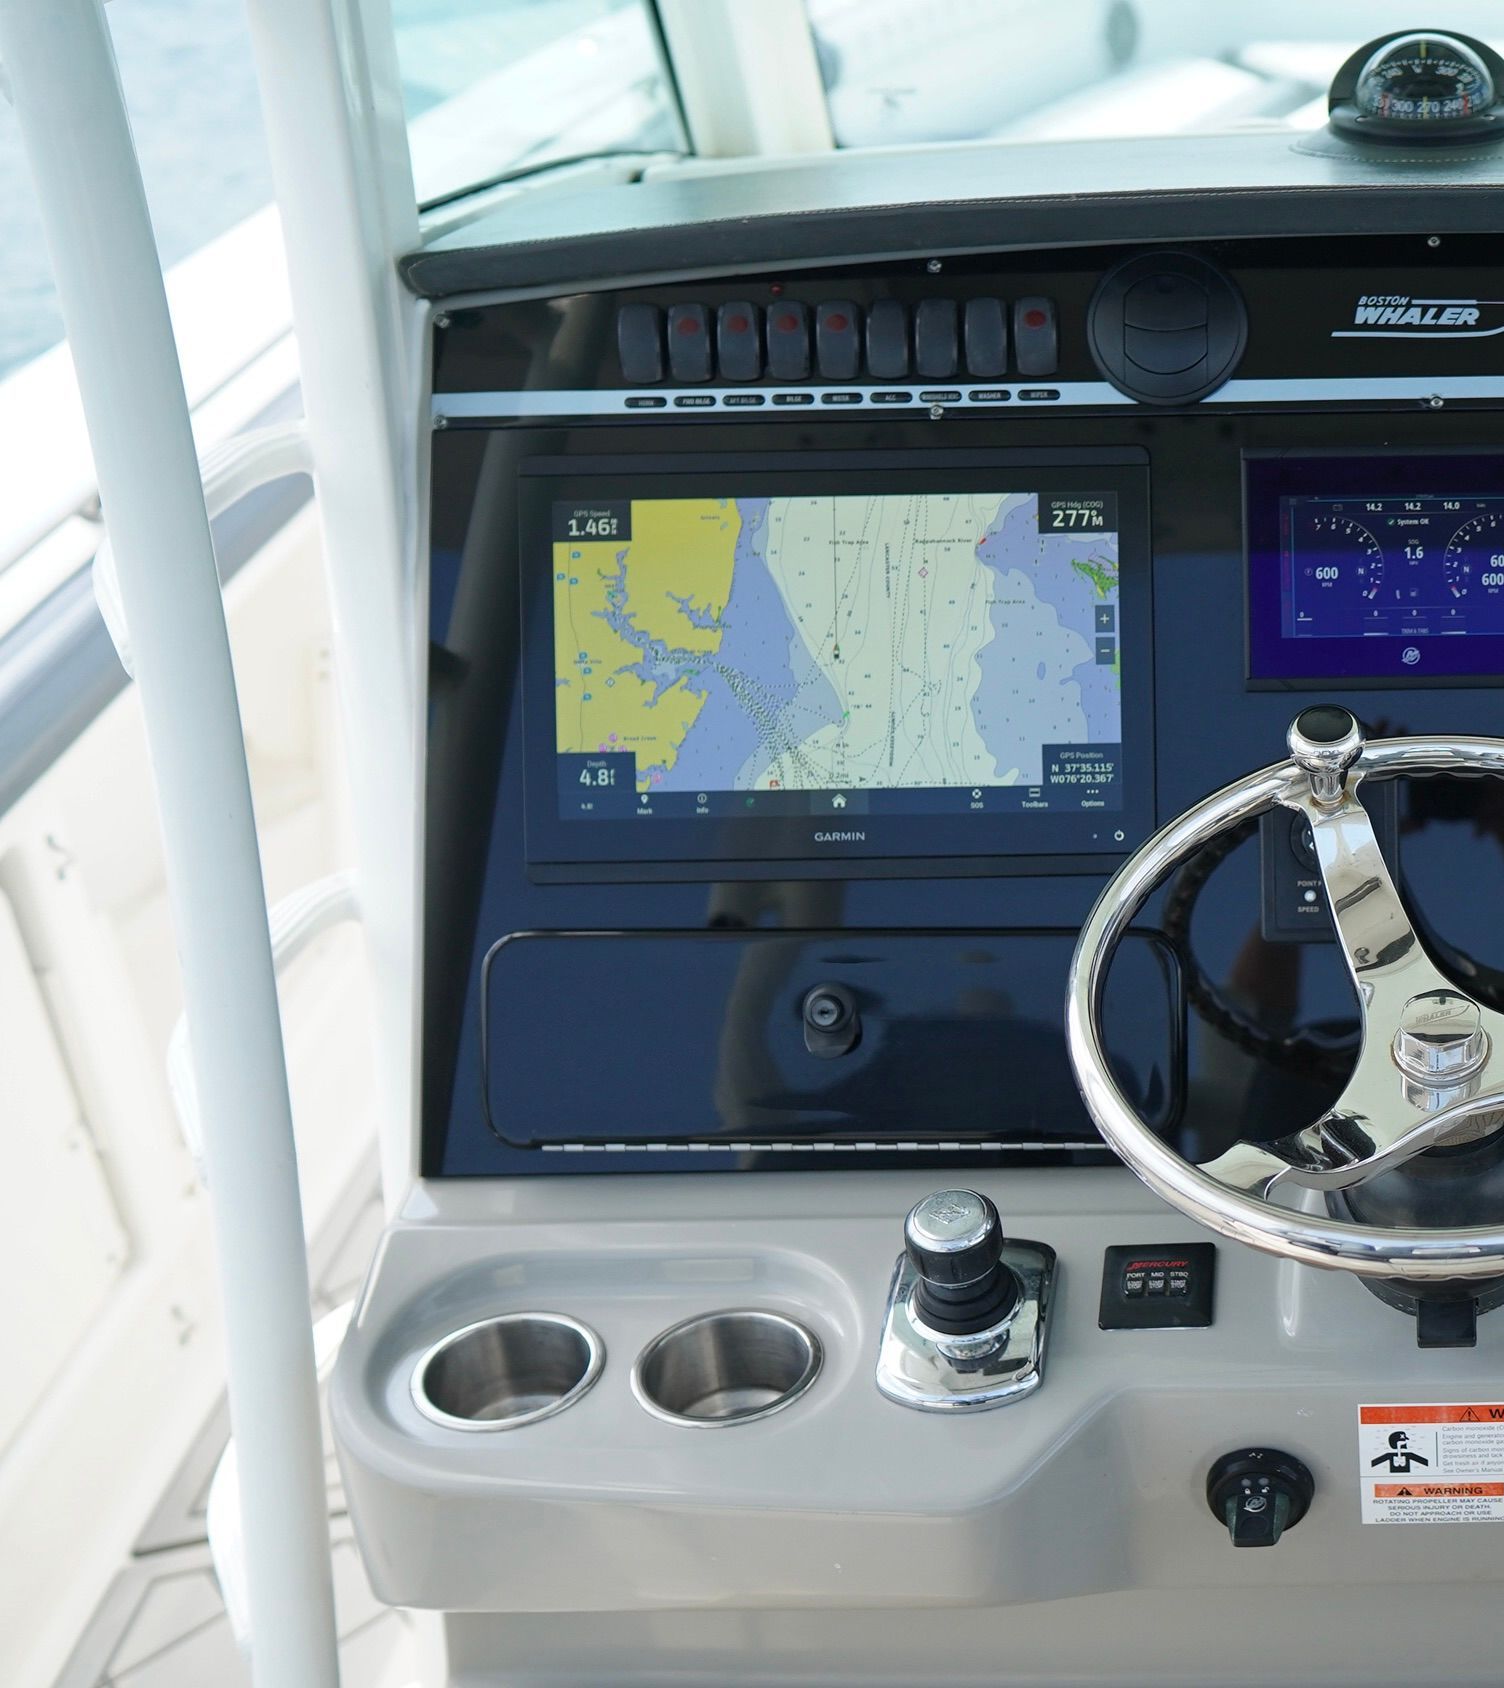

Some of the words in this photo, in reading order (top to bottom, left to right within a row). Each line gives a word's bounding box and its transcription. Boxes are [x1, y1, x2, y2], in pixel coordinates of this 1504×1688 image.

[1358, 296, 1409, 305] BOSTON
[1354, 307, 1480, 325] WHALER
[1051, 501, 1066, 509] GPS
[1067, 501, 1081, 509] Hdg
[1083, 501, 1103, 509] (COG)
[1366, 503, 1382, 511] 14.2
[1405, 503, 1421, 511] 14.2
[1443, 502, 1460, 510] 14.0
[590, 510, 610, 518] Speed
[568, 519, 610, 536] 1.46
[1404, 547, 1424, 559] 1.6
[1315, 567, 1338, 580] 600
[1481, 573, 1504, 586] 600
[587, 760, 607, 768] Depth
[1052, 764, 1059, 773] N
[1081, 800, 1104, 808] Options
[637, 807, 652, 815] Mark
[696, 806, 709, 814] Info
[814, 832, 865, 841] GARMIN
[1126, 1261, 1188, 1271] MERCURY
[1424, 1487, 1483, 1495] WARNING
